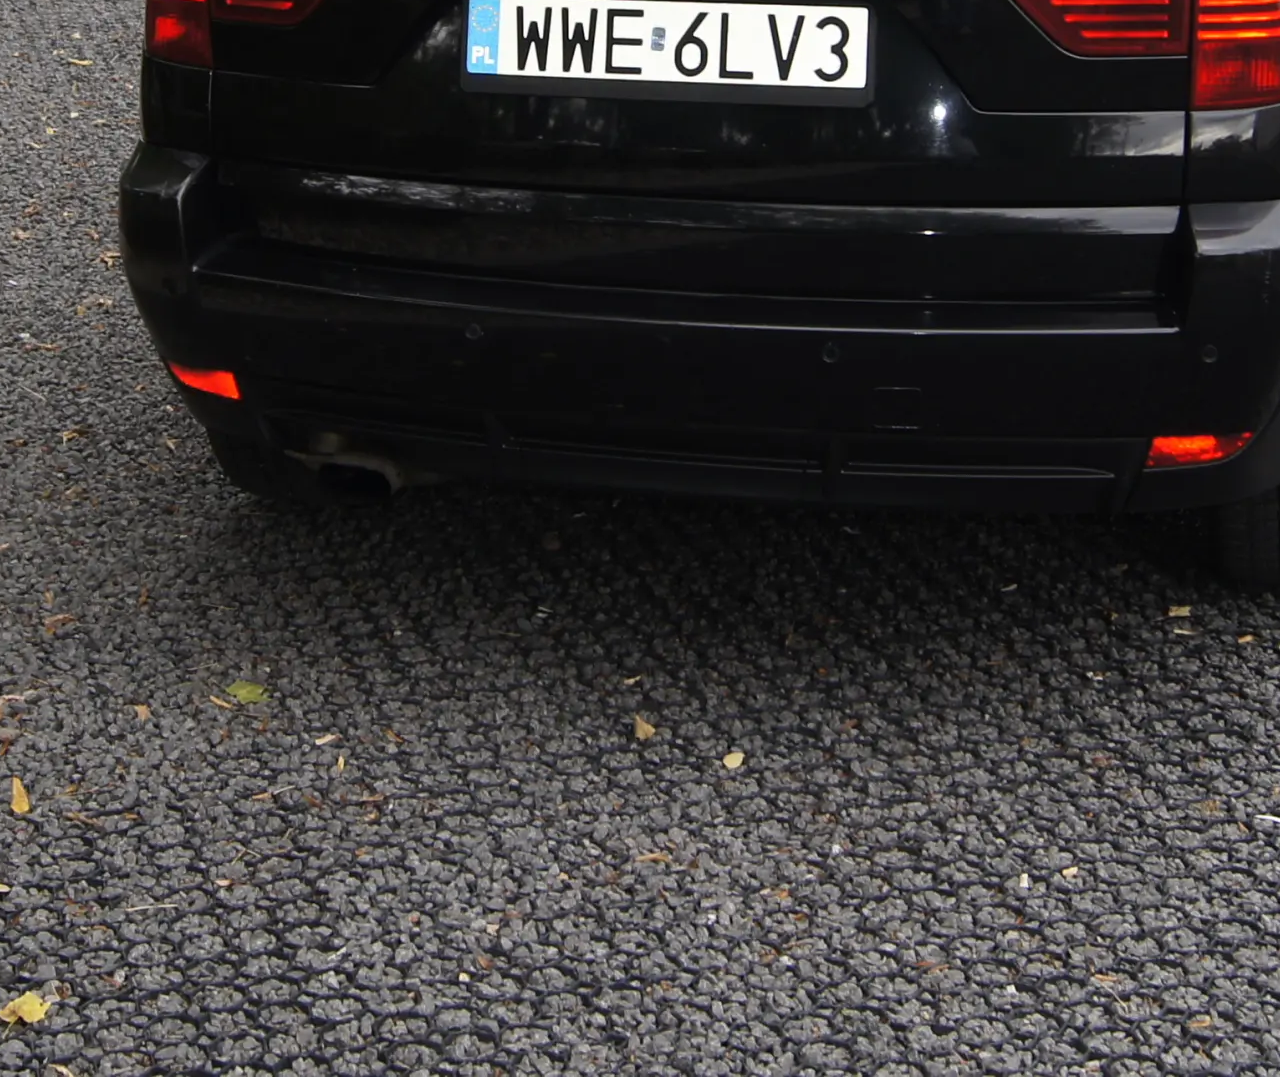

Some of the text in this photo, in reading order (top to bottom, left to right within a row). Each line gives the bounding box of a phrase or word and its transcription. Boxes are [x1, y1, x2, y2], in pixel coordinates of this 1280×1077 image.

[471, 45, 495, 65] PL
[516, 6, 850, 82] WWE 6LV3
